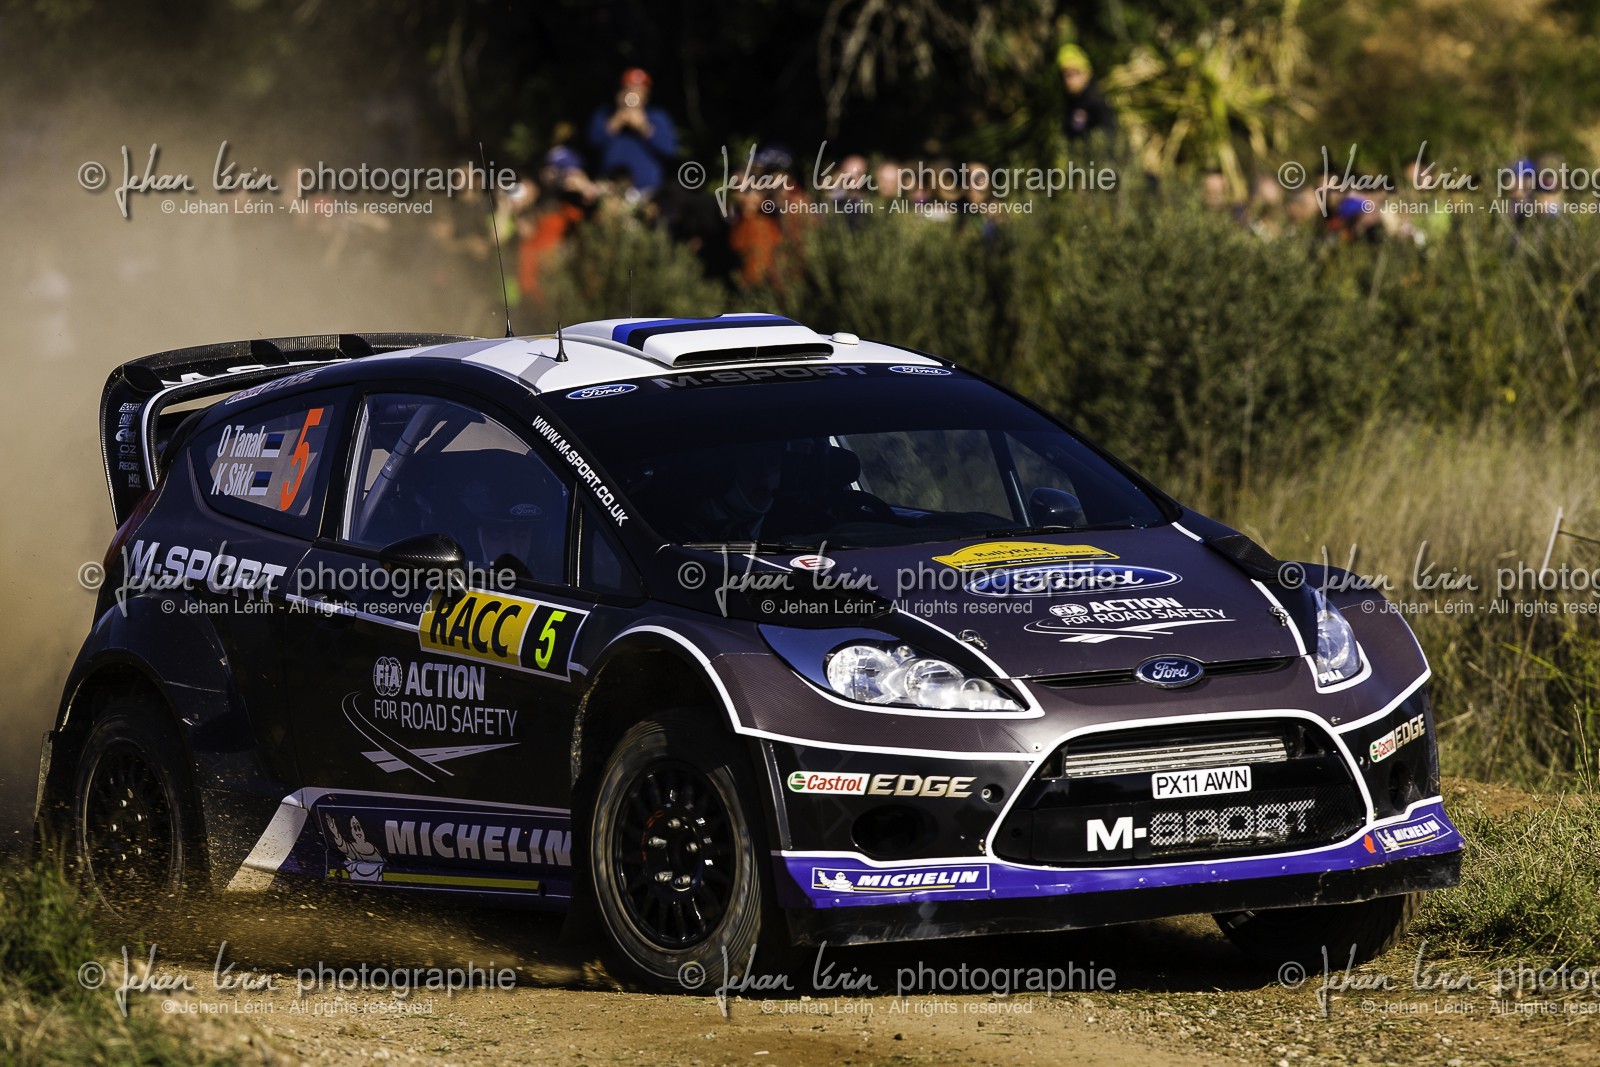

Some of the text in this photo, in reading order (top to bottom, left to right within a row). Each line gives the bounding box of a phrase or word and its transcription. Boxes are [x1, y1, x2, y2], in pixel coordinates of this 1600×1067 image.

[580, 385, 626, 398] Ford
[217, 424, 267, 458] O Tanak
[280, 408, 324, 511] 5
[210, 462, 255, 496] K Sikk
[799, 557, 826, 569] E
[1012, 567, 1145, 593] Ford
[1062, 608, 1226, 626] FOR ROAD SAFETY
[1089, 597, 1183, 613] ACTION
[429, 595, 523, 658] RACC
[535, 610, 568, 670] 5
[405, 661, 486, 701] ACTION
[1152, 660, 1190, 680] Ford
[1319, 670, 1345, 685] PIAA
[374, 699, 518, 737] FOR ROAD SAFETY
[1396, 713, 1426, 750] EDGE
[807, 773, 978, 798] Castrol EDGE
[1156, 769, 1249, 796] PX11 AWN
[385, 819, 572, 867] MICHELIN
[1392, 820, 1441, 841] MICHELIN
[856, 870, 980, 887] MICHELIN
